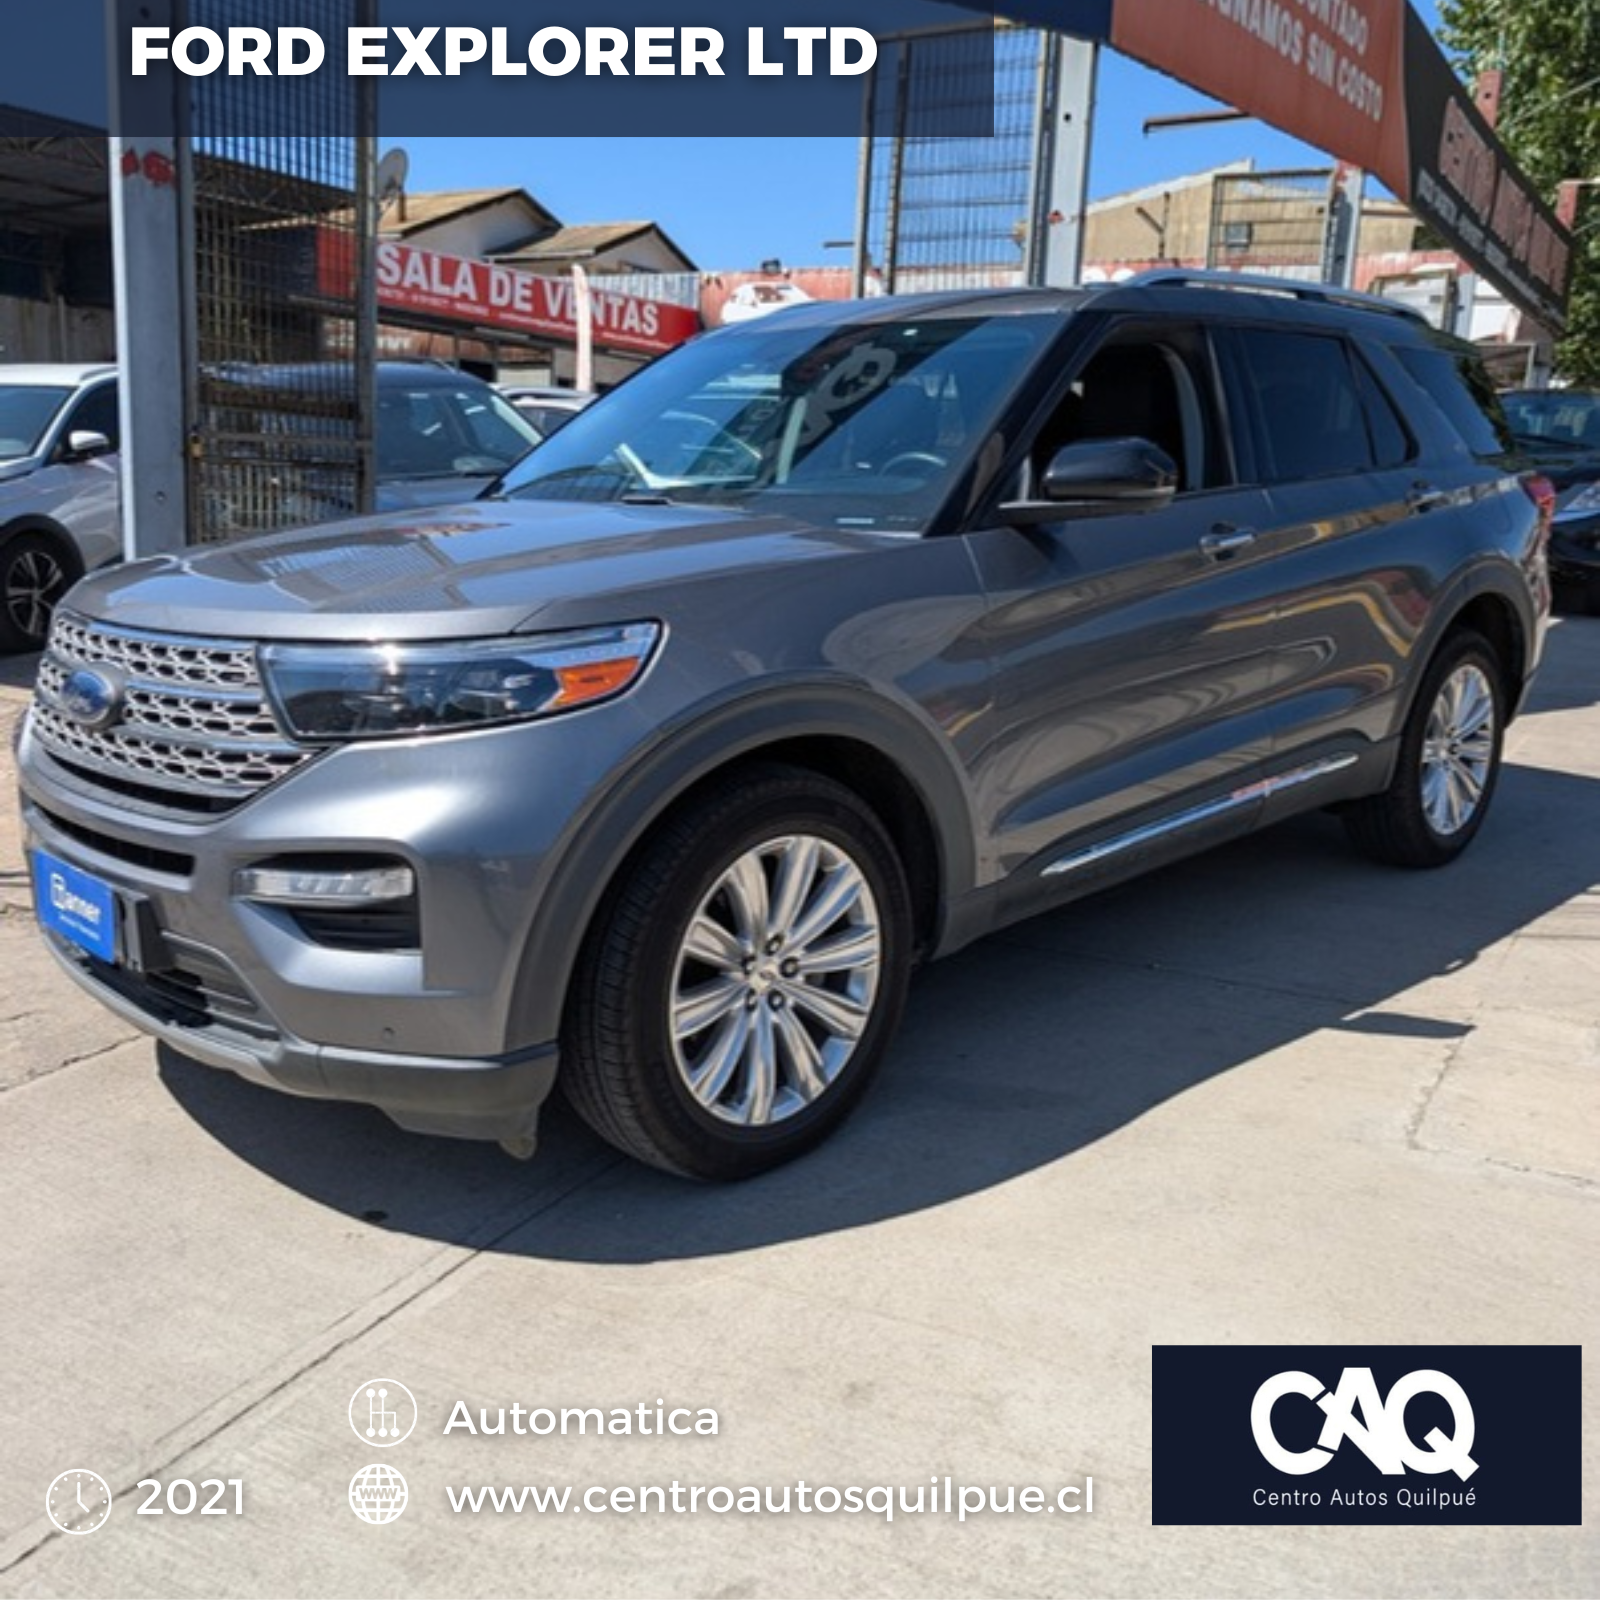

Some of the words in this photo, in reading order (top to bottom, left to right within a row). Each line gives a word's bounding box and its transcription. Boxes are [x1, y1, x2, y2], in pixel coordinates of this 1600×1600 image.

[1305, 32, 1336, 88] SIN
[1336, 56, 1384, 122] COSTO
[376, 243, 477, 301] SALA
[489, 265, 534, 312] DE
[543, 279, 659, 336] VENTAS
